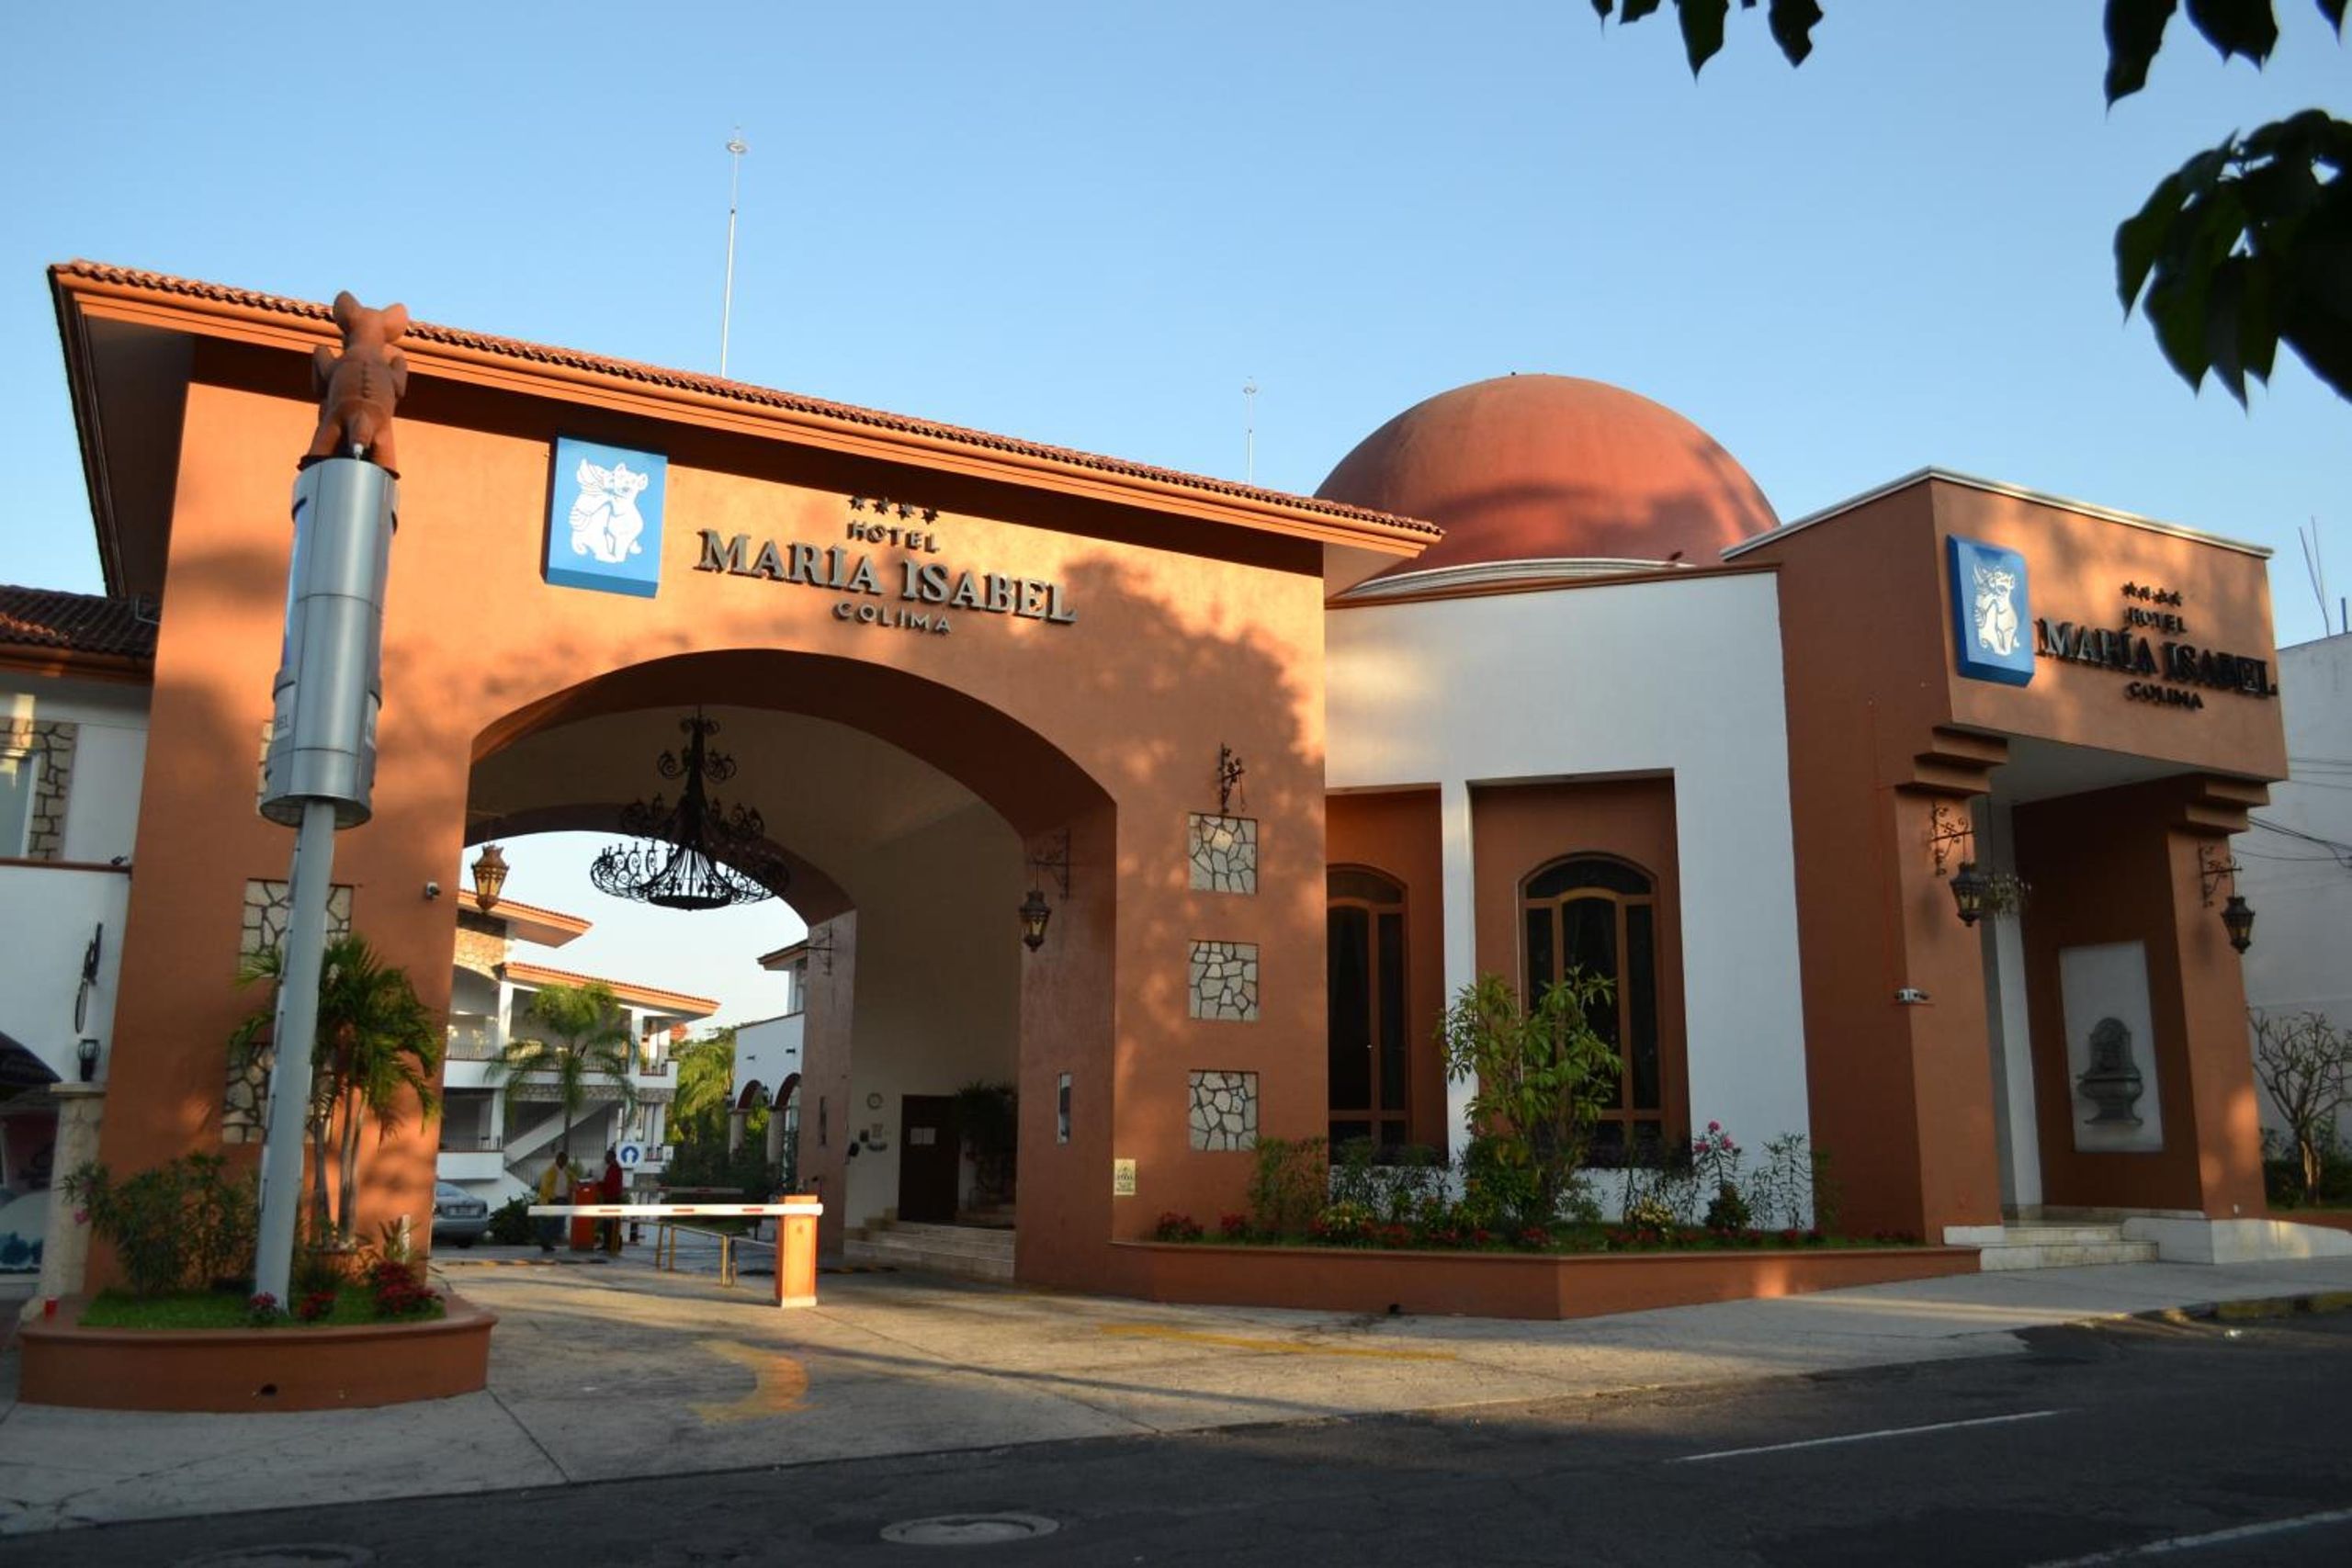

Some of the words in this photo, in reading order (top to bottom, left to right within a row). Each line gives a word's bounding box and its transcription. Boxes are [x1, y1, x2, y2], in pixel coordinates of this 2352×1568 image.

[847, 518, 940, 553] HOTEL
[900, 557, 1079, 624] ISABEL
[832, 601, 952, 635] COLIMA
[2125, 607, 2187, 634] HOTEL
[2161, 642, 2278, 699] ISABEL
[2124, 682, 2204, 709] COLIMA
